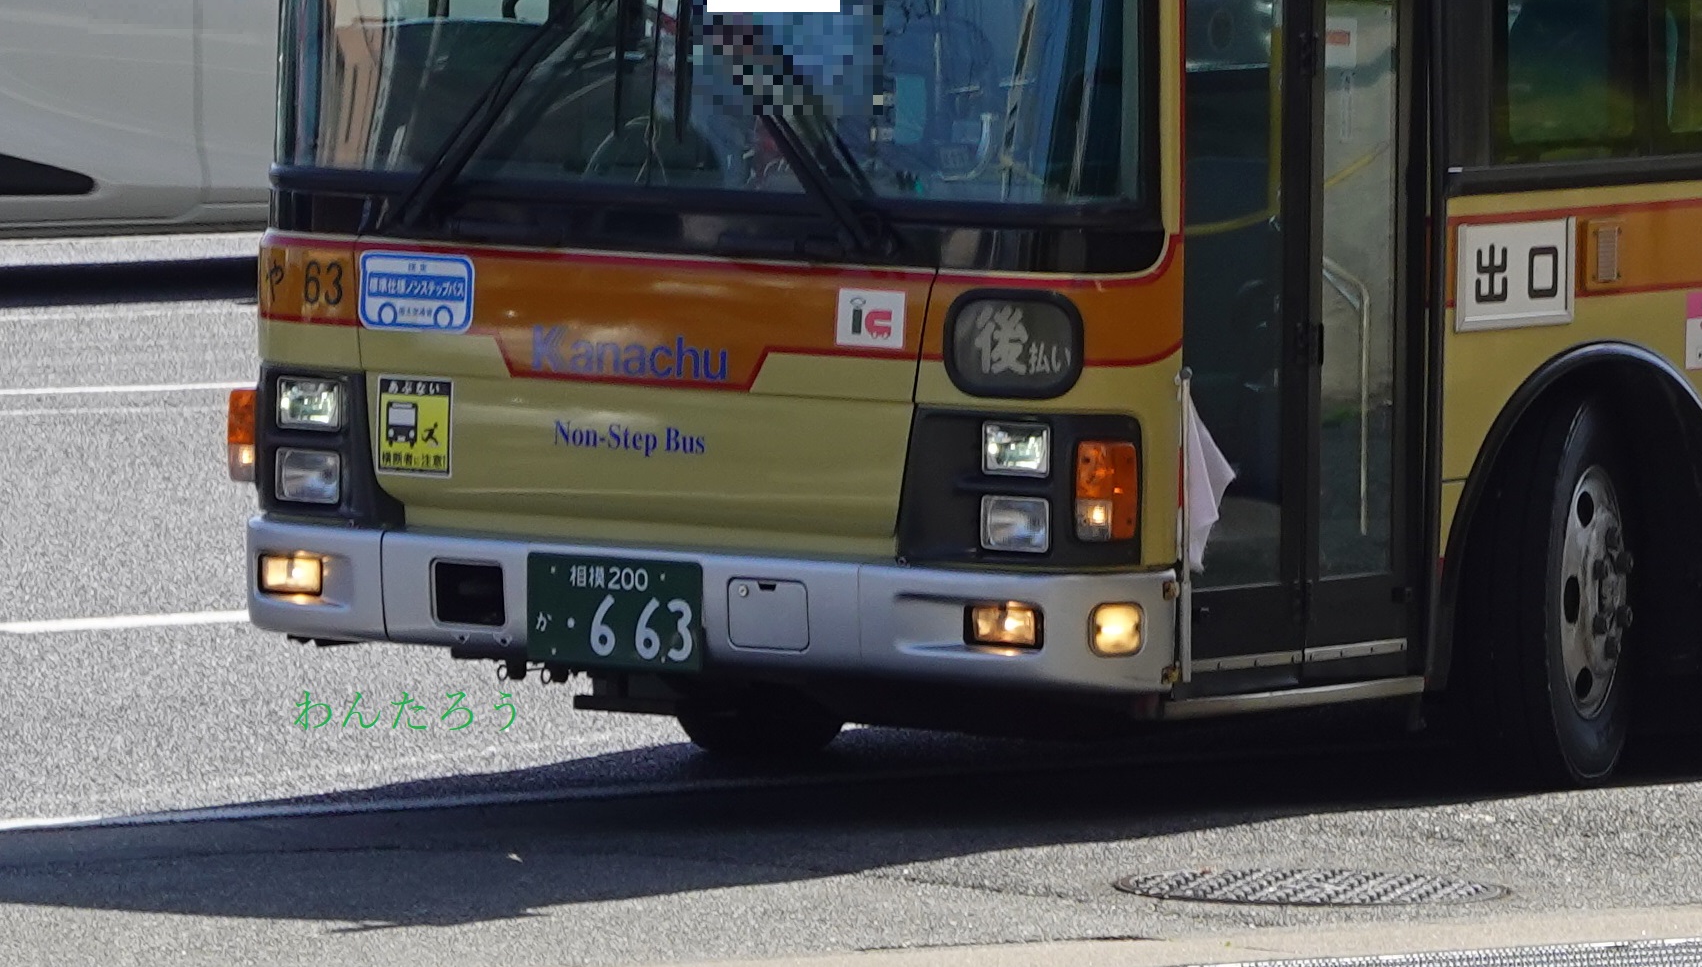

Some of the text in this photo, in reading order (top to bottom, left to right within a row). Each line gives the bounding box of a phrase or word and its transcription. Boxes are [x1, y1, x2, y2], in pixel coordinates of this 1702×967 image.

[304, 260, 344, 306] 63
[1475, 244, 1559, 305] 出口
[530, 323, 728, 382] Kanachu
[974, 304, 1072, 376] 後払い
[553, 418, 706, 458] Non-Step Bus
